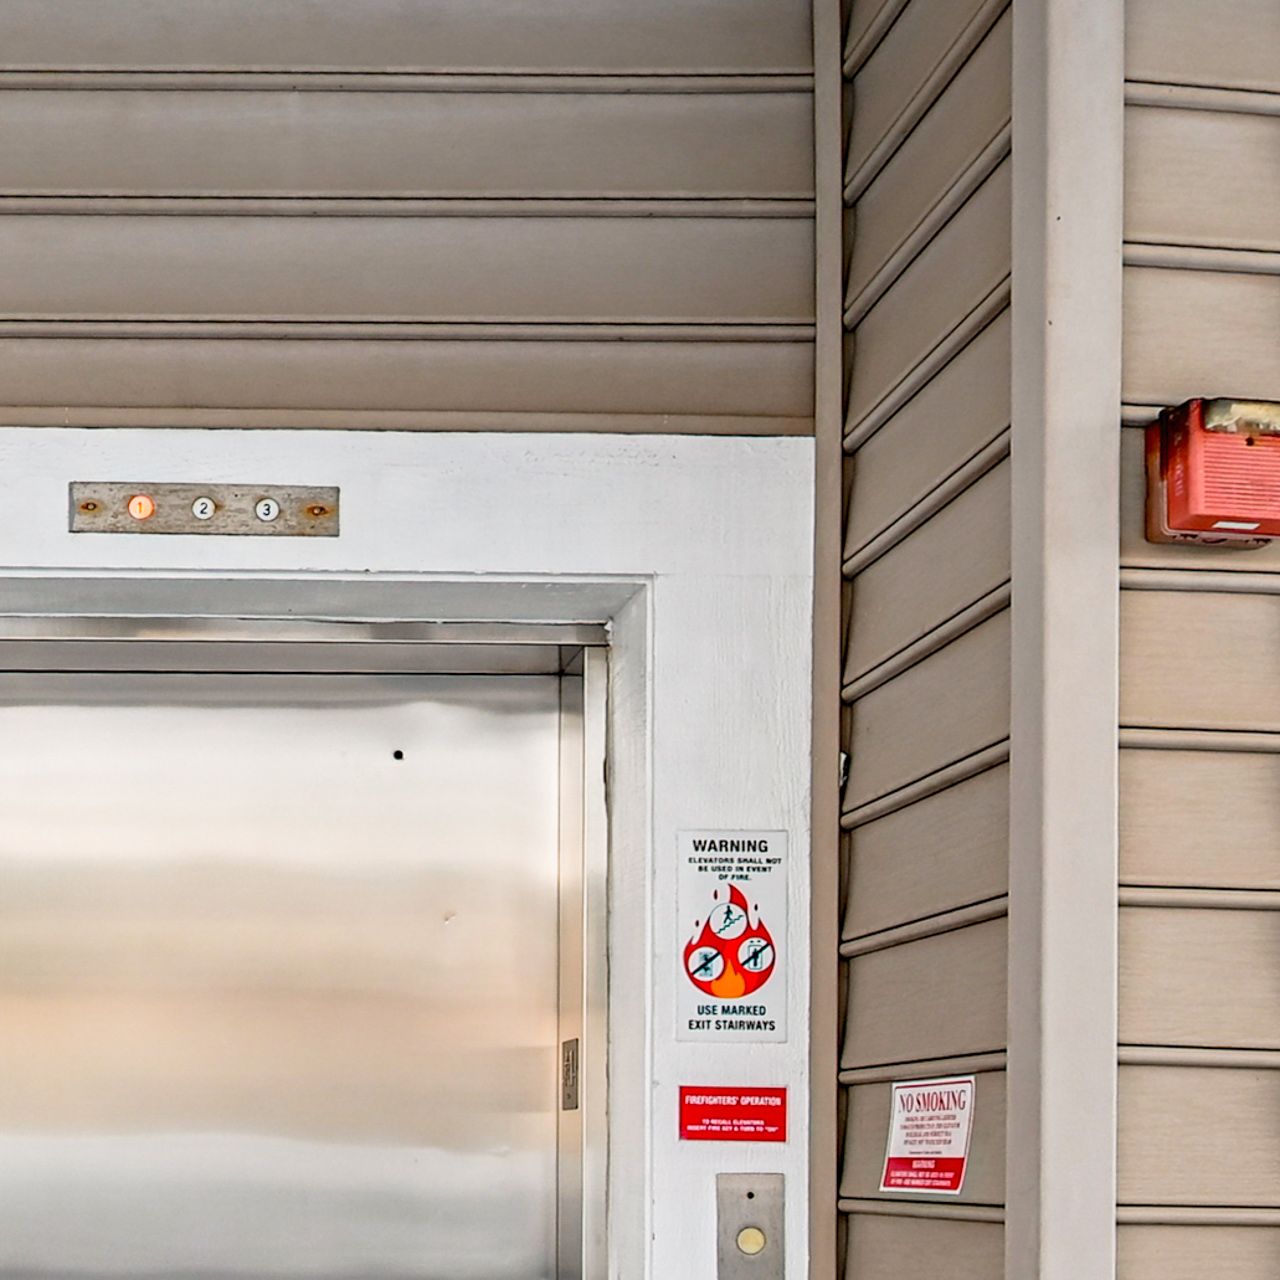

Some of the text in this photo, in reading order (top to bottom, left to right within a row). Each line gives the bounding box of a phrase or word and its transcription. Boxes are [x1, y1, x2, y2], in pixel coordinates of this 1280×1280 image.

[693, 839, 768, 853] WARNING
[737, 857, 763, 865] SHALL
[746, 865, 772, 873] EVENT
[697, 1005, 766, 1016] USE MARKED
[688, 1019, 776, 1031] EXIT STAIRWAYS
[740, 1095, 781, 1107] OPERATION
[898, 1089, 967, 1114] NO SMOKING
